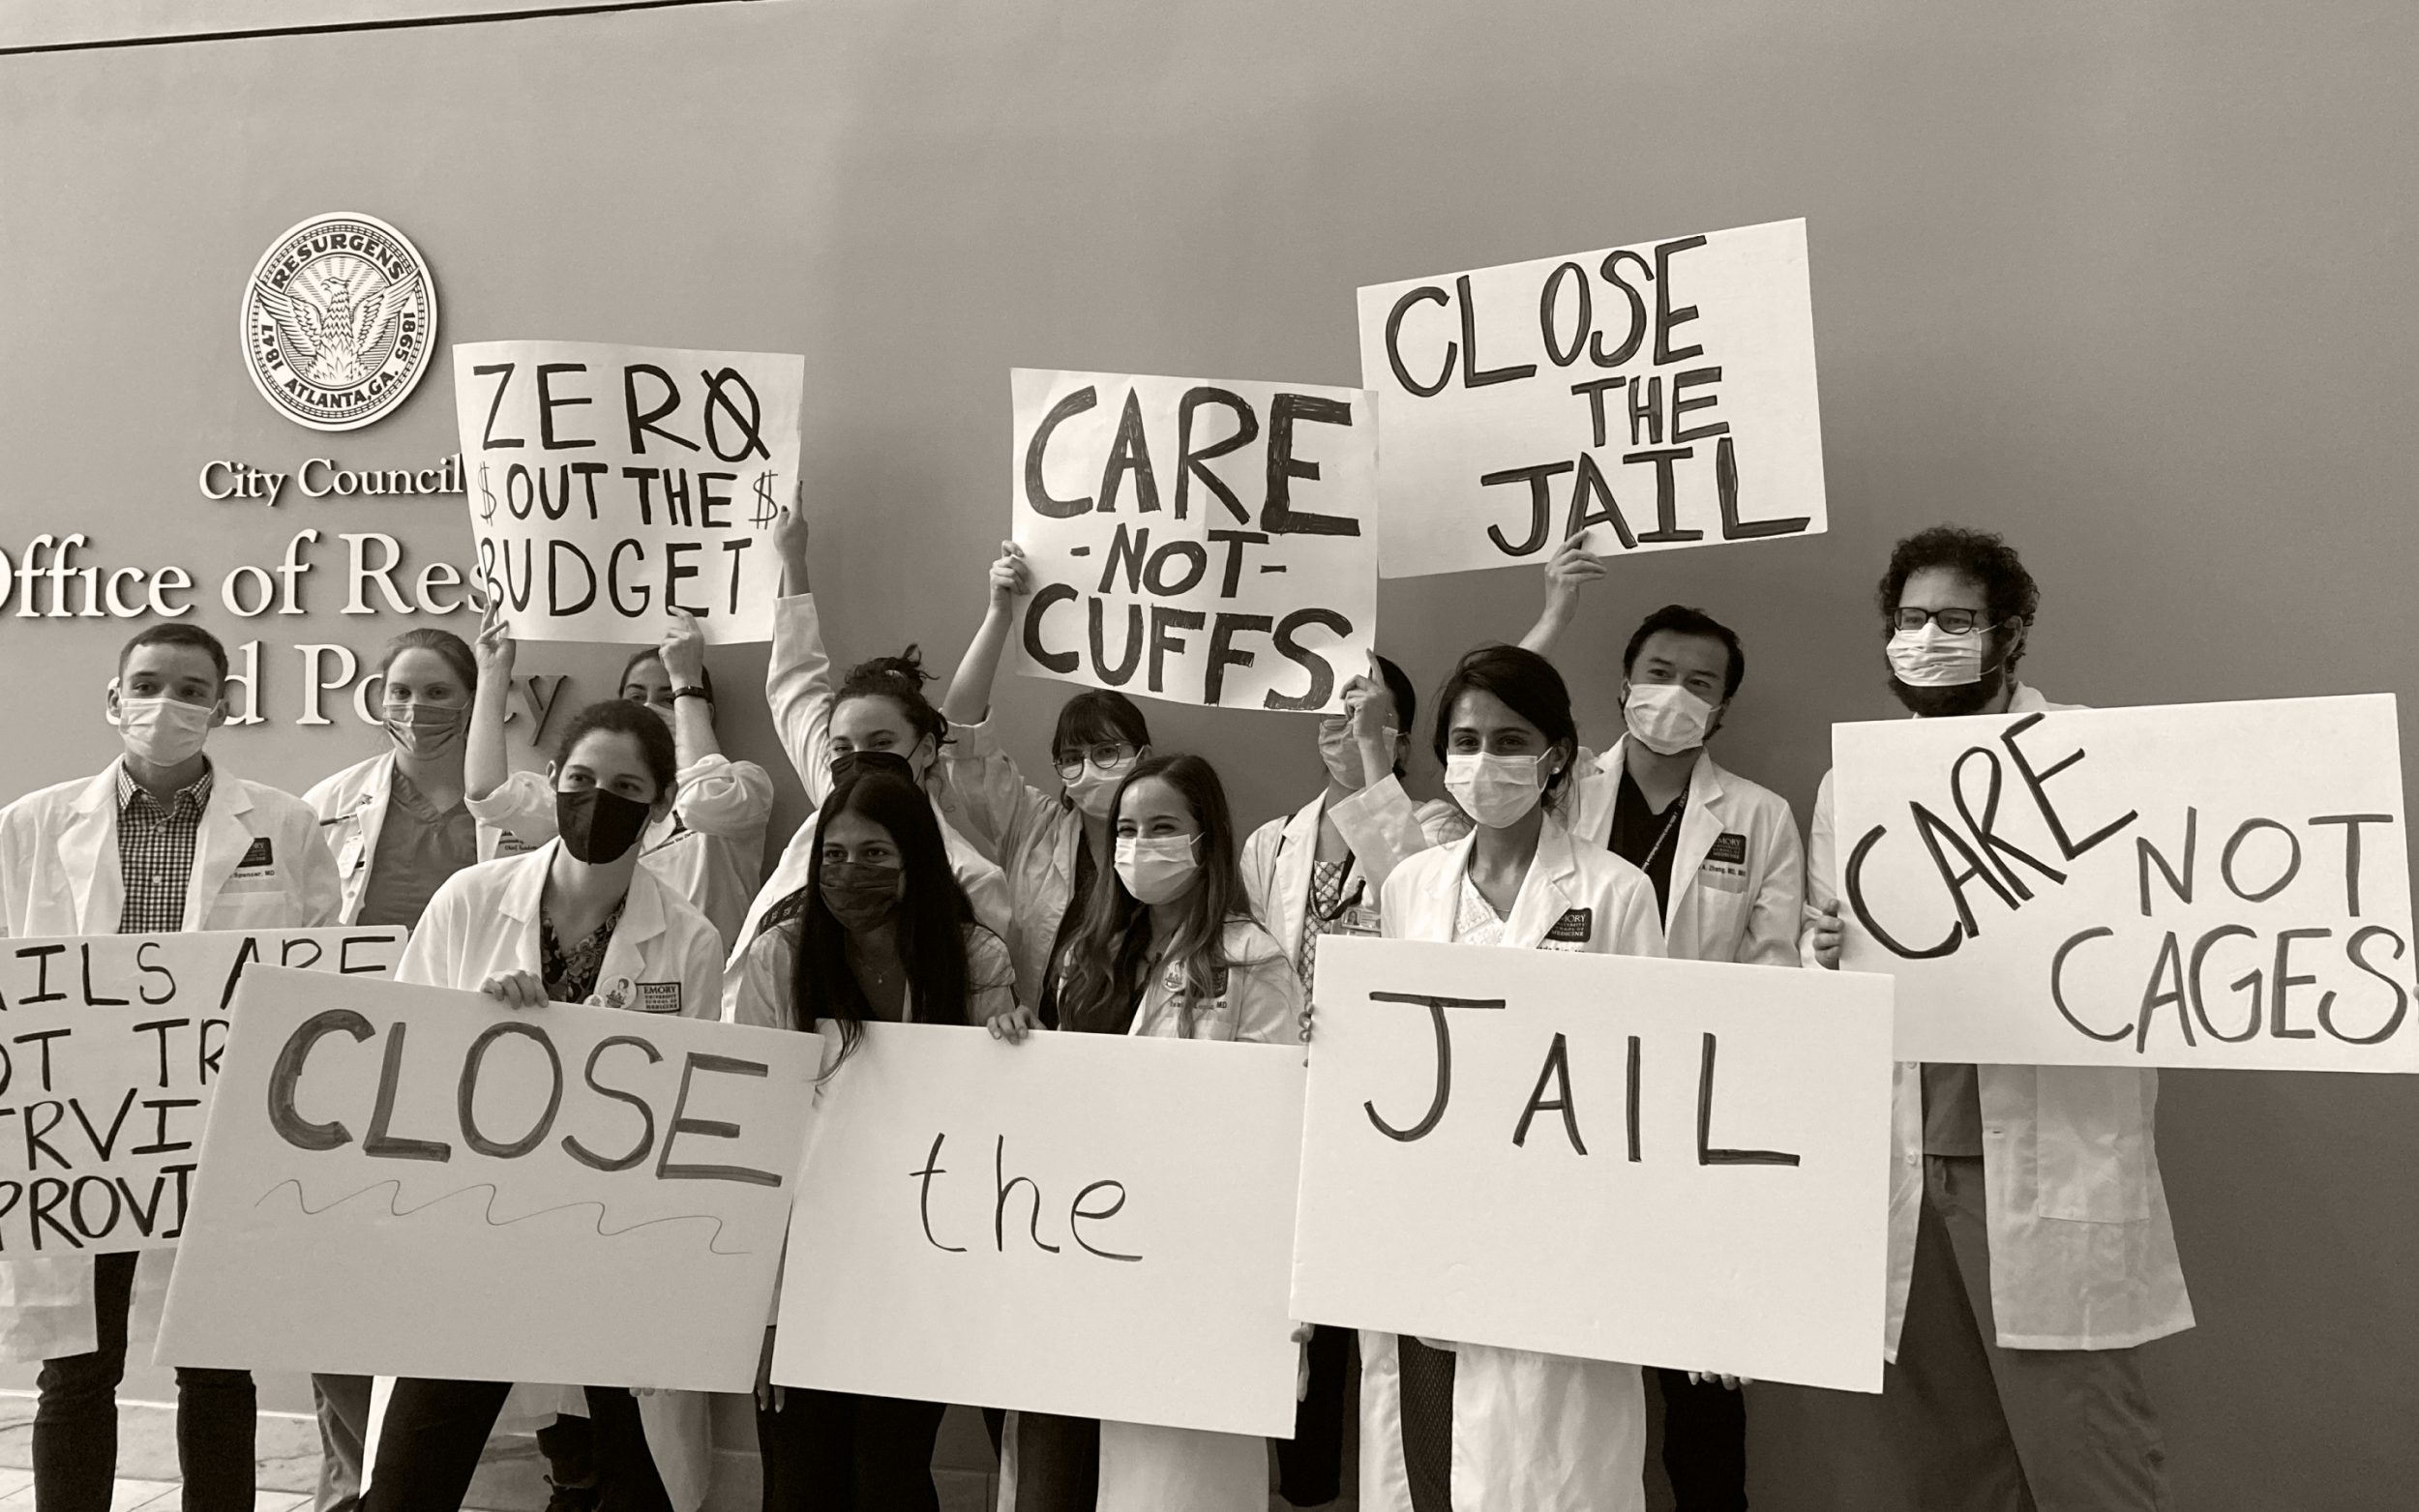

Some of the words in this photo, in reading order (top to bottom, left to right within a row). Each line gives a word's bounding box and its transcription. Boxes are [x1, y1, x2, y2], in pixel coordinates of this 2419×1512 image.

[271, 233, 404, 290] RESURGENS
[260, 324, 285, 371] 1847
[395, 311, 416, 363] 1865
[1386, 235, 1707, 398] CLOSE
[1571, 367, 1729, 448] THE
[199, 460, 285, 506] City
[298, 453, 463, 497] Council
[622, 466, 738, 528] THE
[1025, 385, 1360, 536] CARE
[1480, 437, 1810, 556] JAIL
[0, 533, 193, 617] ffice
[222, 529, 318, 617] of
[481, 537, 752, 618] BUDGET
[1023, 583, 1353, 711] CUFFS
[1845, 712, 2138, 960] CARE
[2136, 806, 2394, 917] NOT
[0, 942, 176, 1011] ILS
[643, 986, 675, 994] EMORY
[2051, 924, 2408, 1053] CAGES
[267, 1008, 783, 1188] CLOSE
[1364, 992, 1800, 1167] JAIL
[0, 1087, 201, 1171] RVI
[909, 1132, 1143, 1261] the
